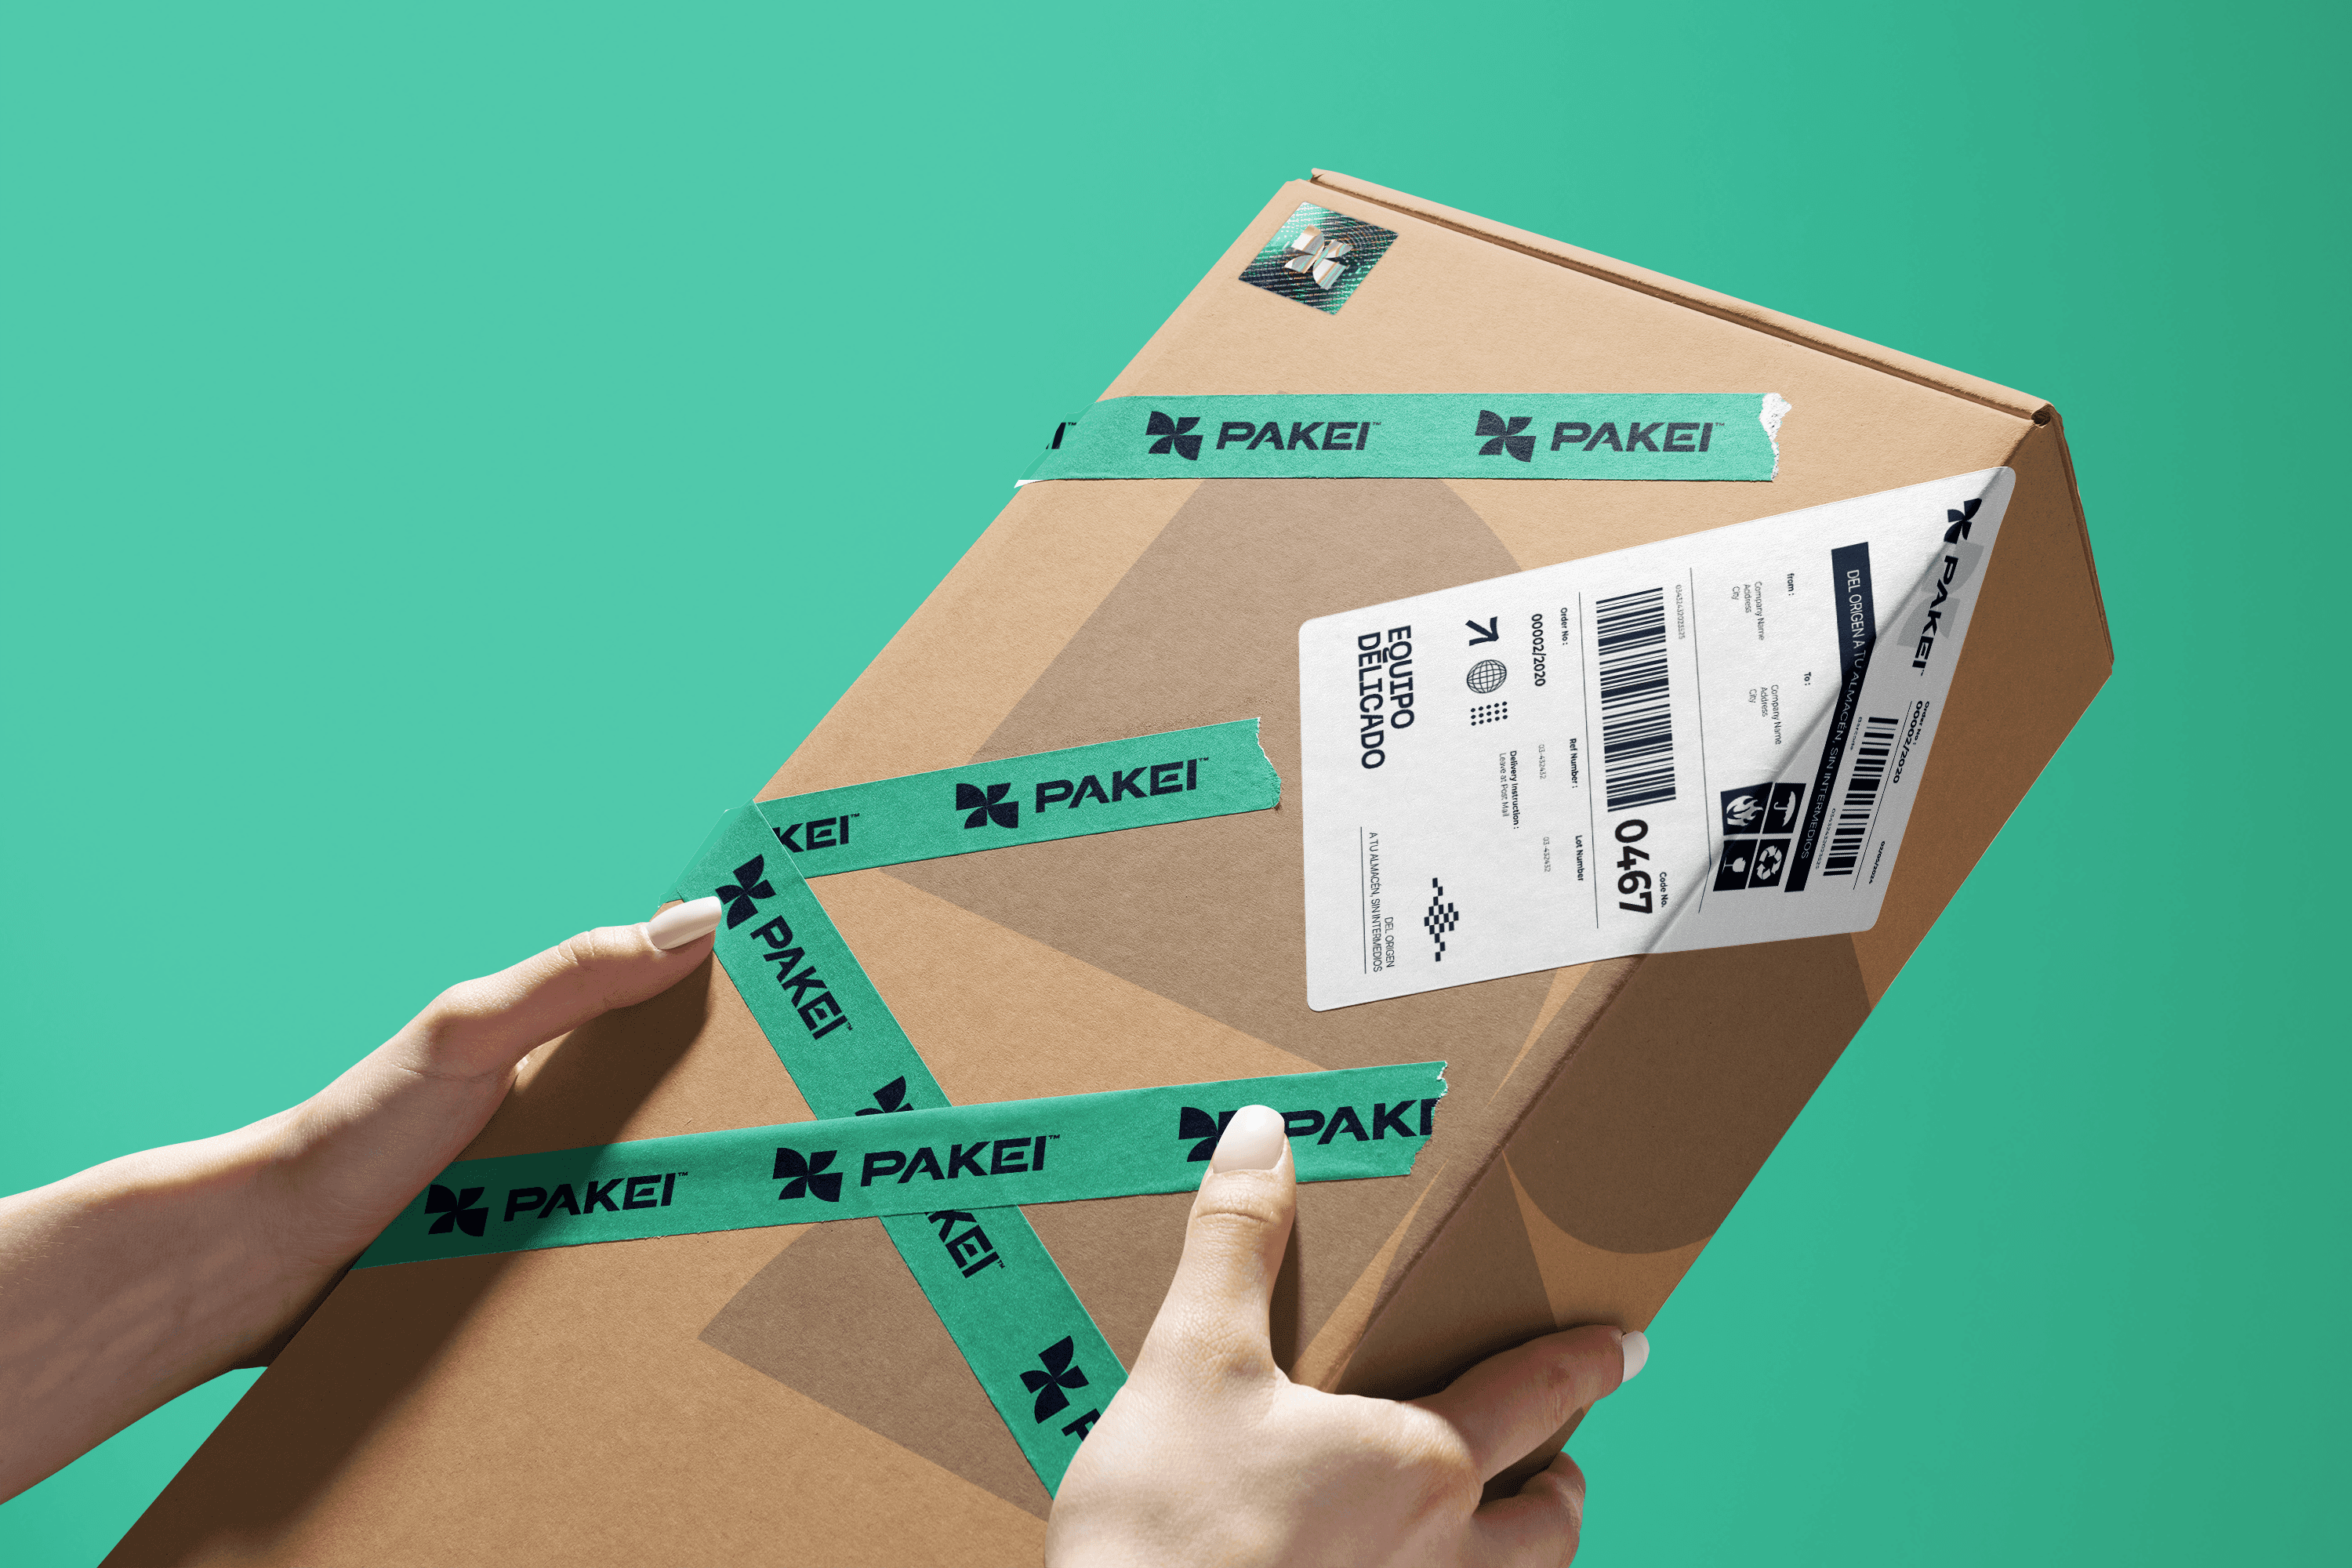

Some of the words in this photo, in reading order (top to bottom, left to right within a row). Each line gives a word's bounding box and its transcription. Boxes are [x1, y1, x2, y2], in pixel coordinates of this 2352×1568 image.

[1731, 586, 1740, 601] City
[1846, 569, 1860, 593] DEL
[1755, 581, 1763, 616] Company
[1849, 593, 1864, 638] ORIGEN
[1531, 613, 1547, 687] 00002/2020
[1853, 640, 1865, 649] A
[1853, 650, 1866, 668] TU
[1382, 625, 1414, 729] EQUIPO
[1358, 632, 1385, 769] DELICADO
[1748, 689, 1757, 703] City
[1771, 684, 1780, 720] Company
[1832, 671, 1860, 743] ALMACÉN,
[1919, 701, 1930, 727] Order
[1570, 738, 1578, 752] Ref
[1850, 716, 1863, 750] Barcode
[1893, 700, 1923, 783] 00002/2020
[1509, 750, 1518, 782] Delivery
[1826, 746, 1838, 770] SIN
[1512, 783, 1520, 826] Instruction
[1801, 772, 1831, 859] INTERMEDIOS
[1370, 839, 1378, 852] TU
[1615, 818, 1653, 914] 0467
[1371, 898, 1381, 913] SIN
[1385, 916, 1393, 934] DEL
[1372, 913, 1382, 972] INTERMEDIOS
[1385, 935, 1396, 967] ORIGEN
